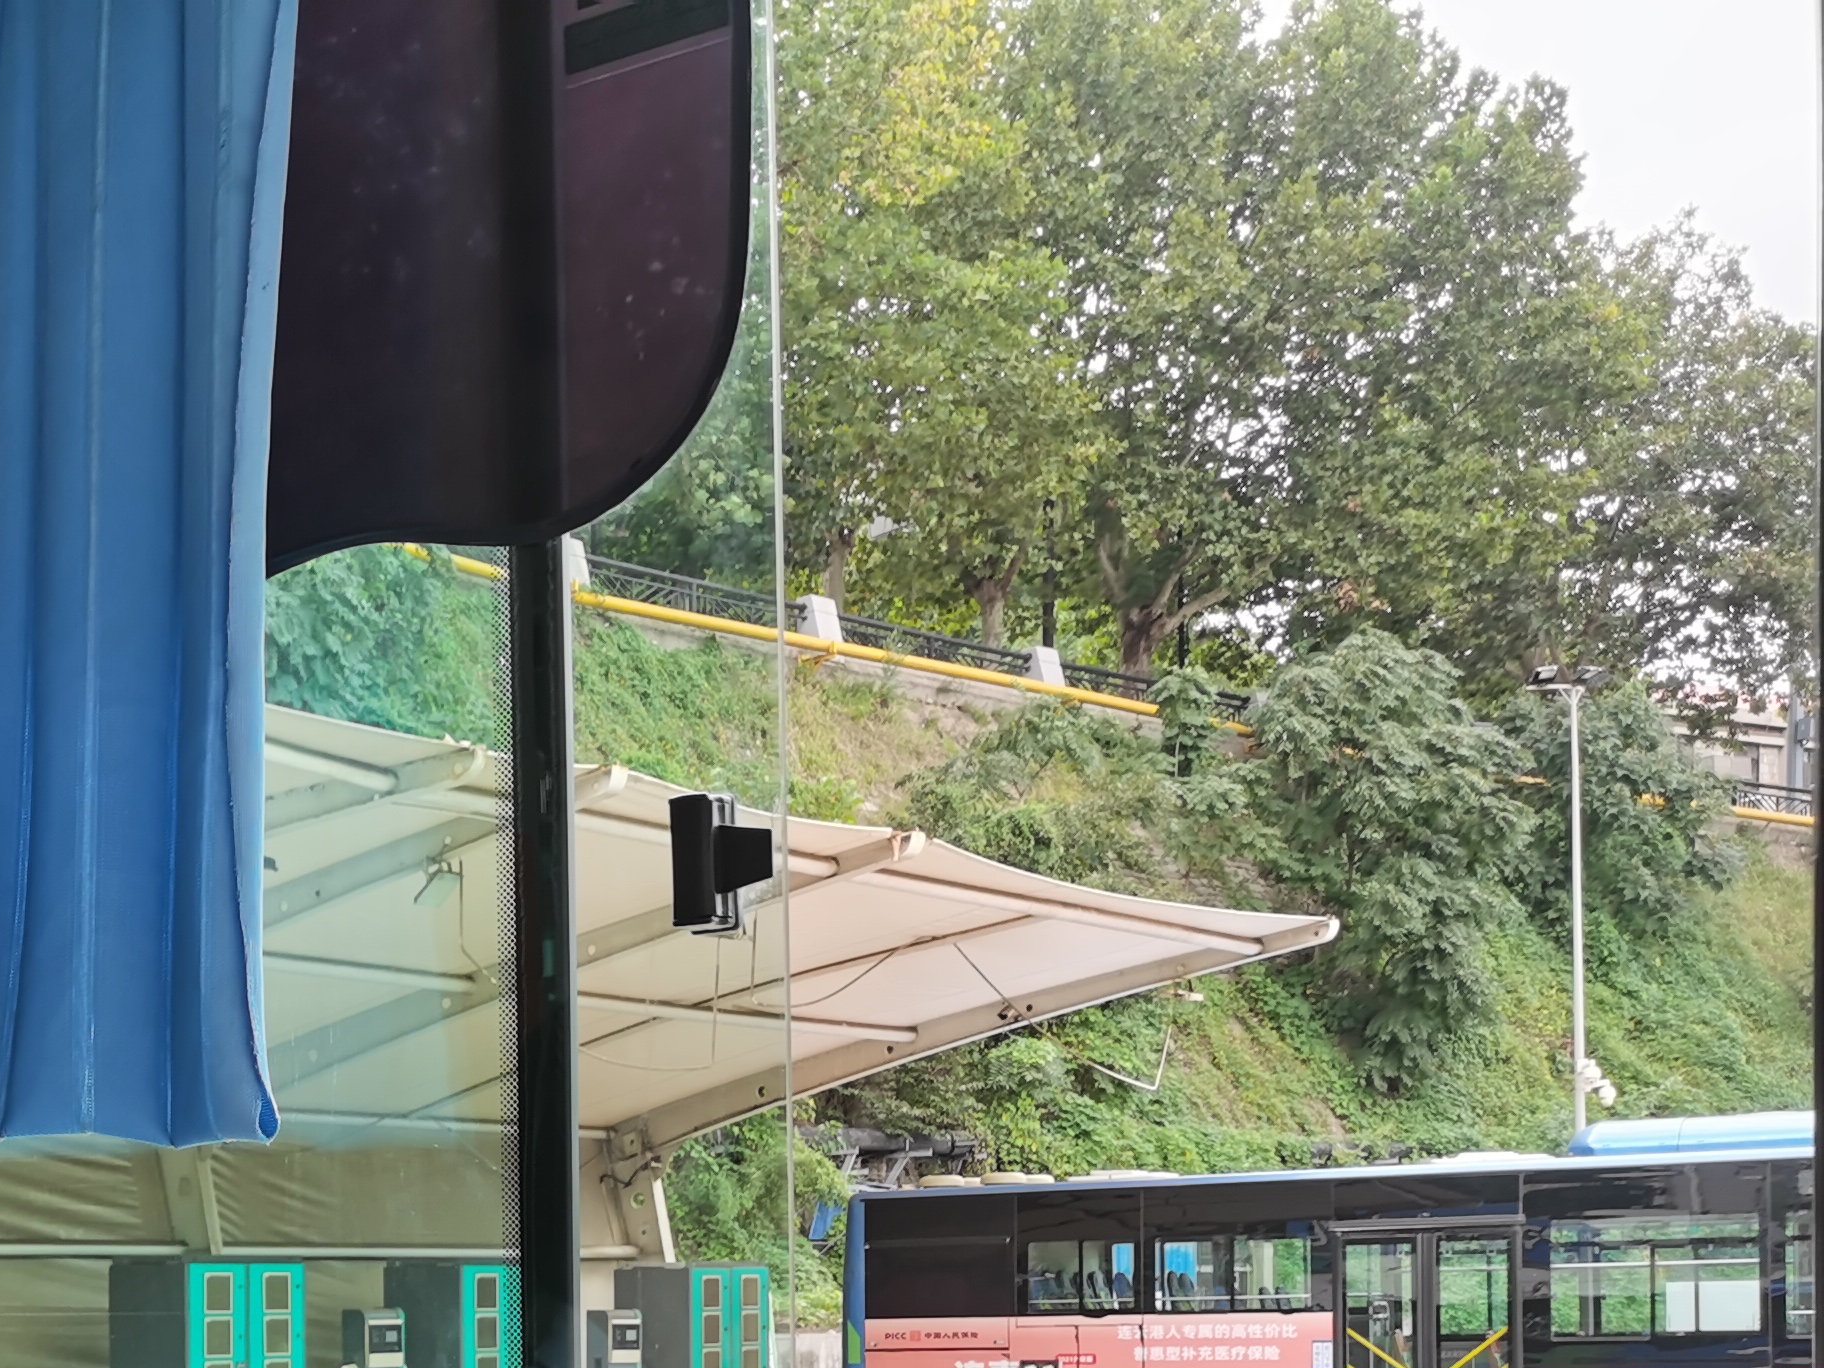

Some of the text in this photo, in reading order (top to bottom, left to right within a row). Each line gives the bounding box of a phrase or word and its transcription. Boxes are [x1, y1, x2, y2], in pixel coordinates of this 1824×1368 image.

[884, 1331, 979, 1341] PICC 中国人民保险
[1117, 1324, 1298, 1340] 连云港人专属的高性价比
[1133, 1346, 1281, 1361] 普惠型补充医疗保险
